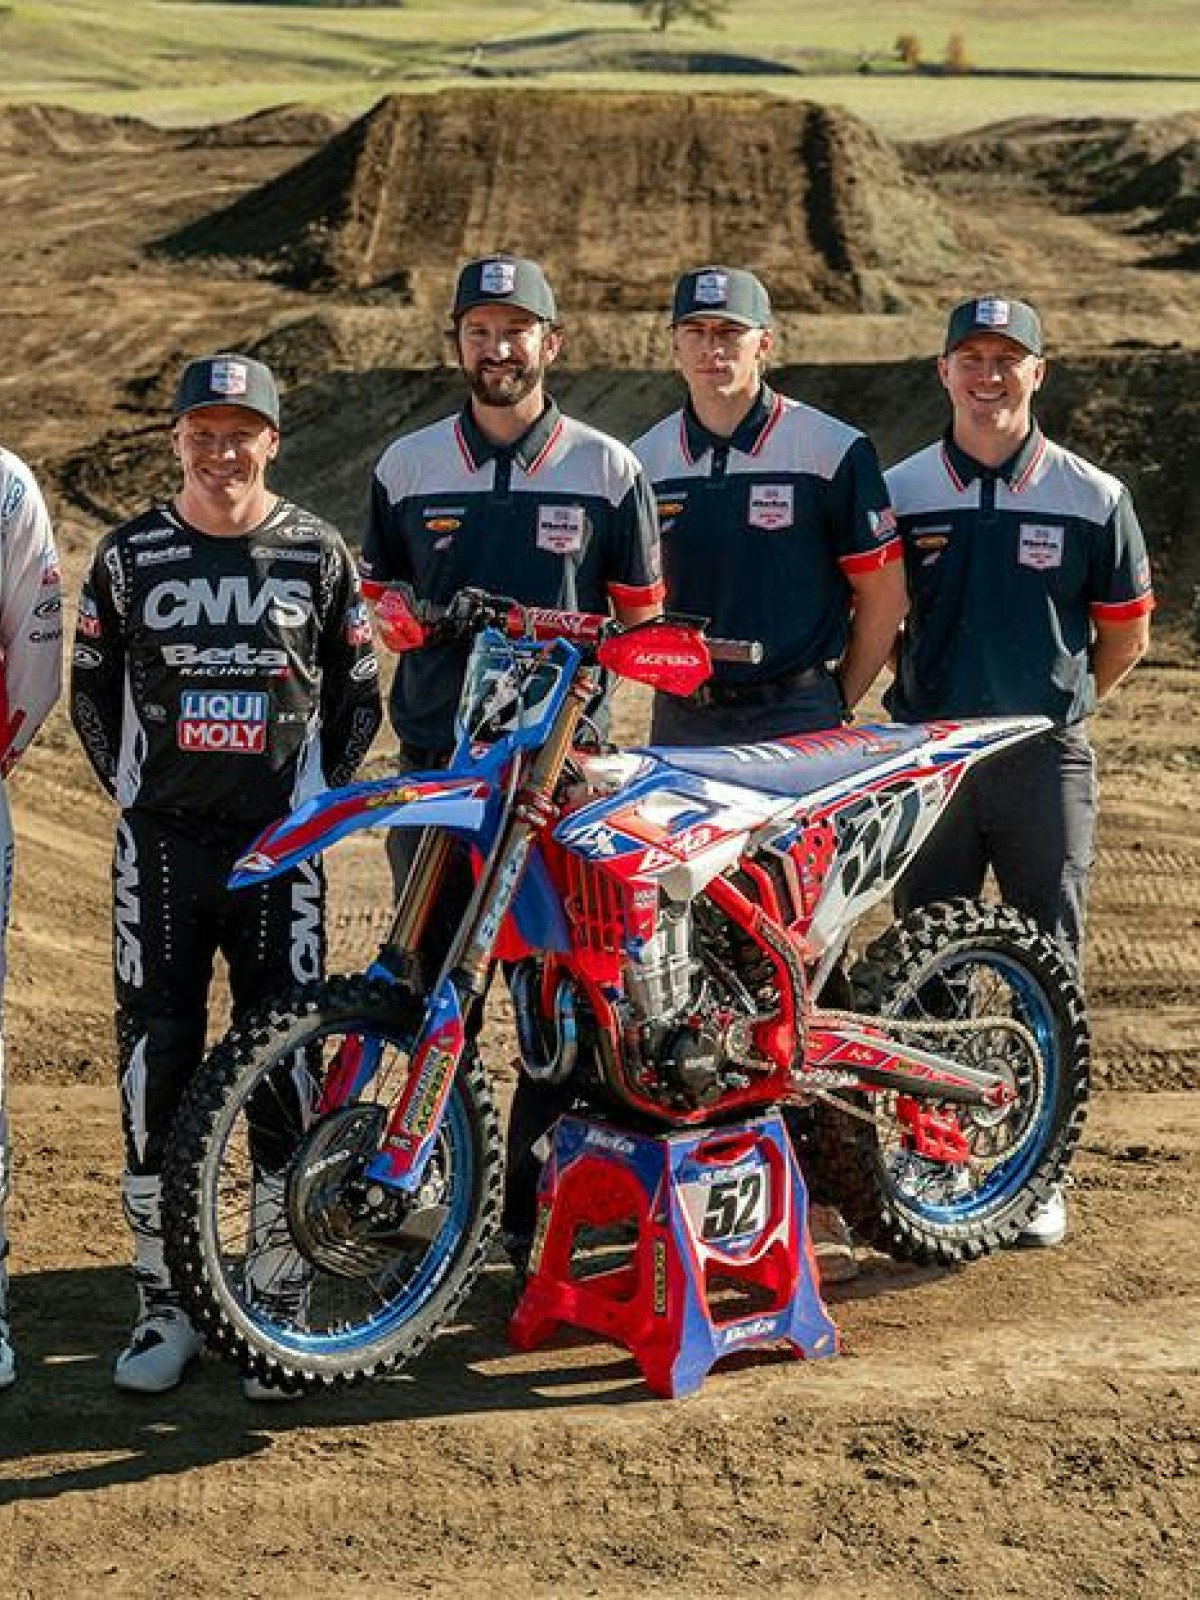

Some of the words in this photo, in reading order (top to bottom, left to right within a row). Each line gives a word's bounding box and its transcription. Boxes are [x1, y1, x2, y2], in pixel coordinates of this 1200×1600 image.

[161, 642, 288, 667] Beta
[179, 667, 257, 678] RACING
[186, 696, 263, 720] LIQUI
[183, 723, 263, 748] MOLY
[702, 1174, 763, 1239] 52
